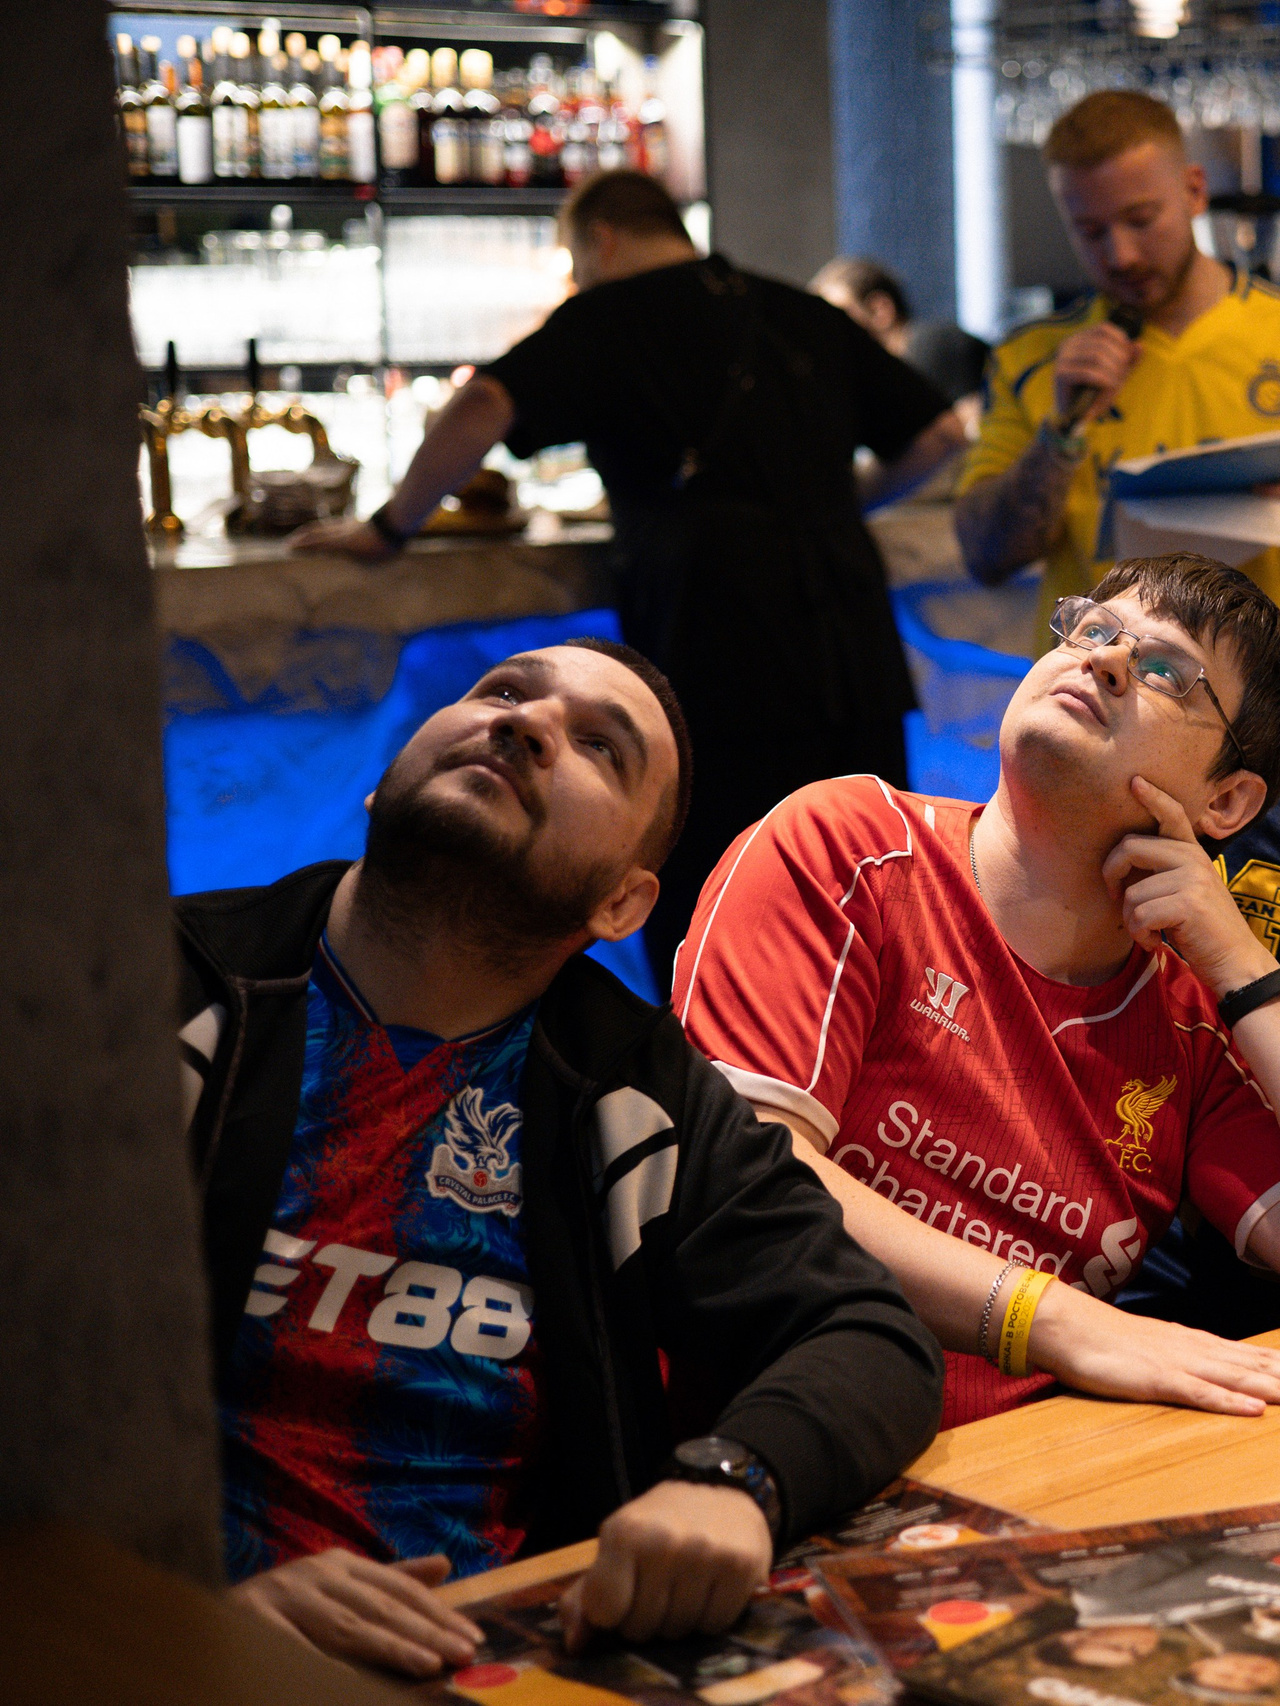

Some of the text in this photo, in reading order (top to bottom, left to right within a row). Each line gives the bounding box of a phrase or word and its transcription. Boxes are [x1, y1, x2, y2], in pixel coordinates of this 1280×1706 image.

[876, 1100, 1093, 1239] Standard
[1119, 1148, 1152, 1174] F.C.
[439, 1177, 471, 1201] CRYSTAL
[472, 1193, 503, 1205] PALACE
